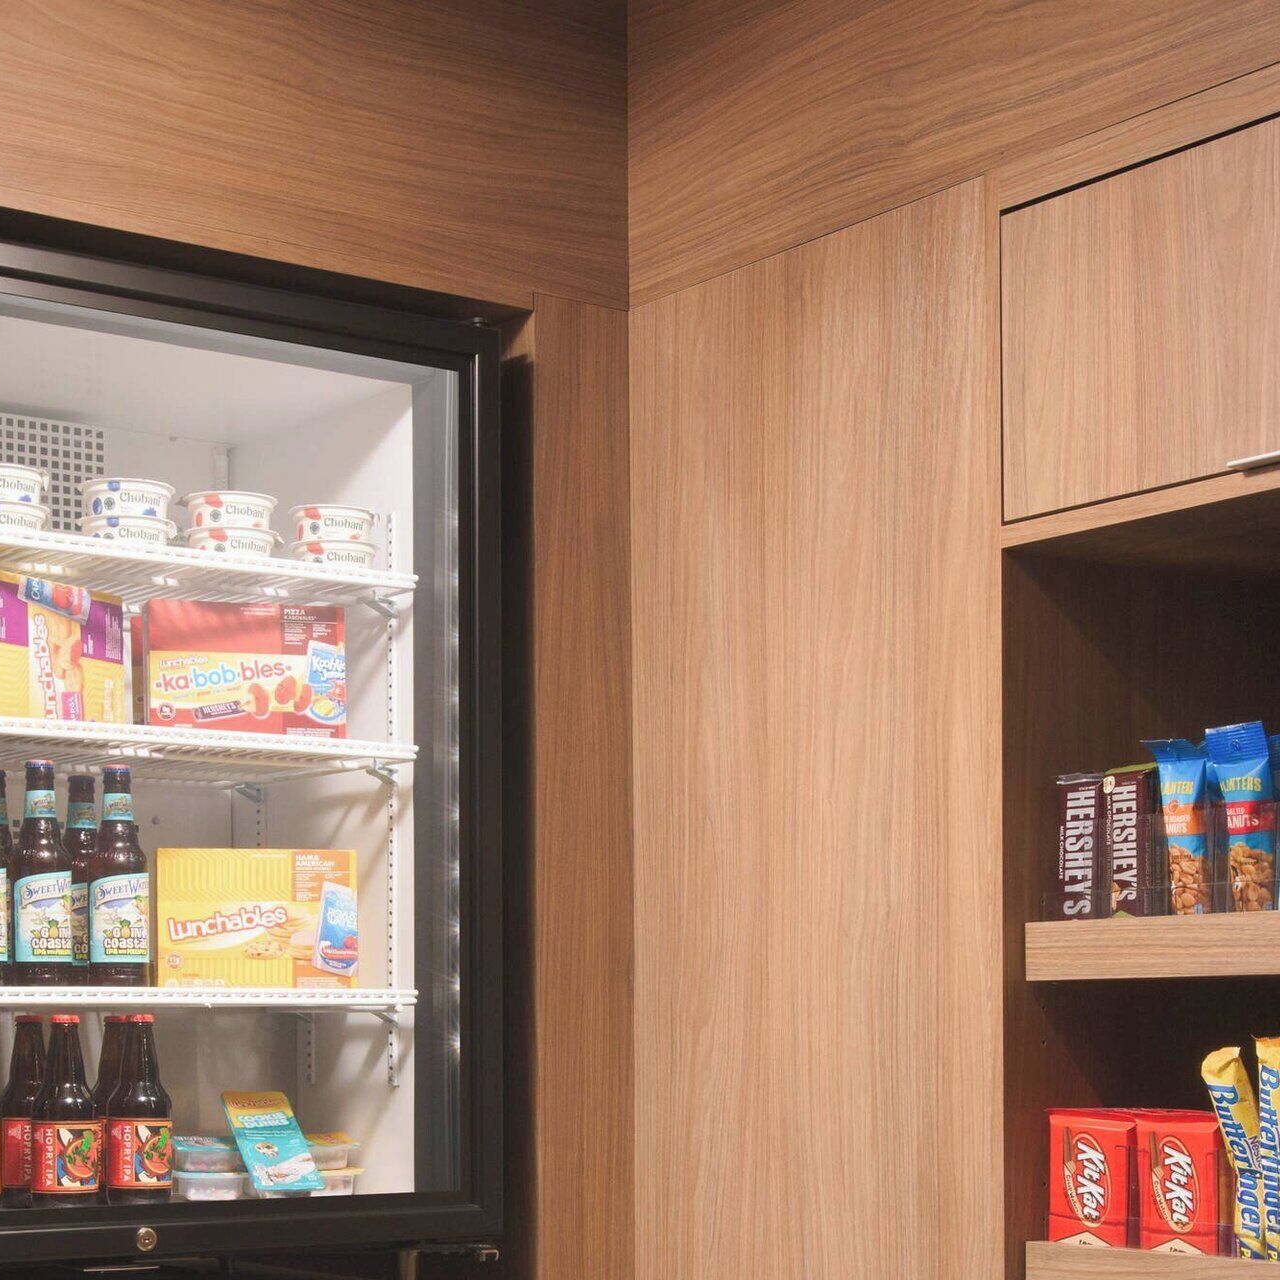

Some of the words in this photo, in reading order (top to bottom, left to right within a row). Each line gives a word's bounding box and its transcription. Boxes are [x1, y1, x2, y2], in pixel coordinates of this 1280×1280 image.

[120, 491, 160, 507] Chobani
[225, 503, 265, 519] Chobani
[324, 515, 363, 532] Chobani
[119, 527, 160, 543] Chobani
[230, 537, 267, 553] Chobani
[327, 551, 366, 566] Chobani
[1063, 788, 1096, 915] HERSHEY'S
[1111, 784, 1138, 902] HERSHEY'S
[168, 905, 289, 941] Lunchables
[45, 1169, 53, 1186] IPA
[123, 1165, 131, 1182] IPA
